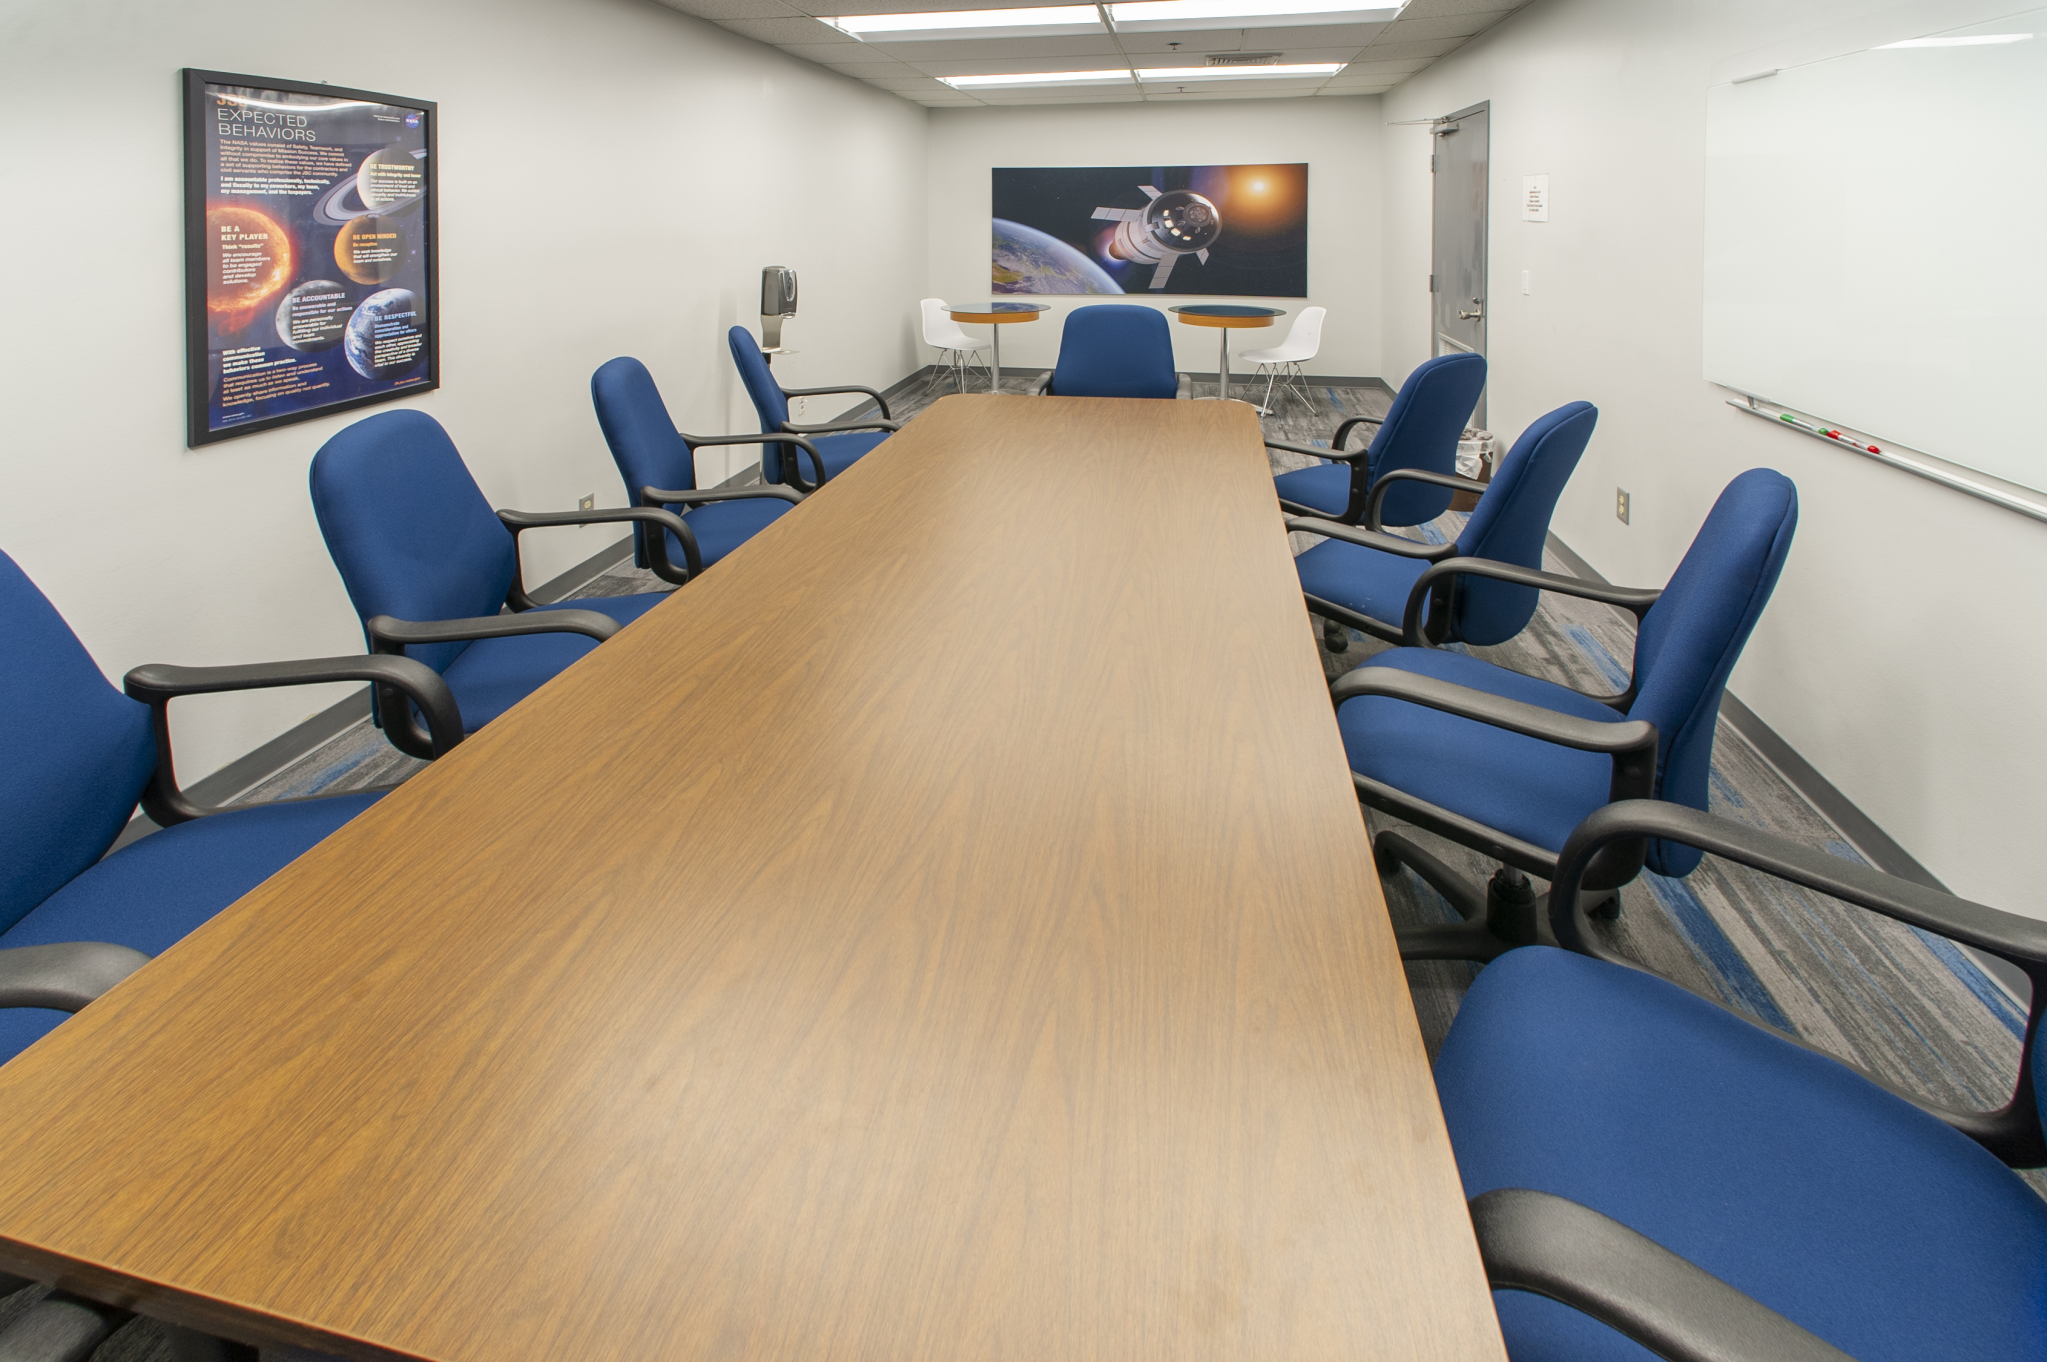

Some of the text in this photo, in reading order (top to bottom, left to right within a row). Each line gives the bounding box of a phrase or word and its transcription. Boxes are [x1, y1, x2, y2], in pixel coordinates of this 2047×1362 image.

[218, 108, 307, 127] EXPECTED
[218, 123, 316, 141] BEHAVIORS
[220, 144, 243, 152] Integrity
[250, 146, 271, 154] support
[242, 152, 275, 160] compromise
[302, 293, 346, 302] ACCOUNTABLE
[384, 311, 417, 320] RESPECTFUL
[223, 352, 265, 361] communication
[223, 366, 250, 374] behaviors
[223, 372, 266, 382] Communication
[298, 362, 317, 370] process
[297, 366, 323, 375] understand
[268, 384, 296, 392] information
[255, 393, 276, 401] focusing
